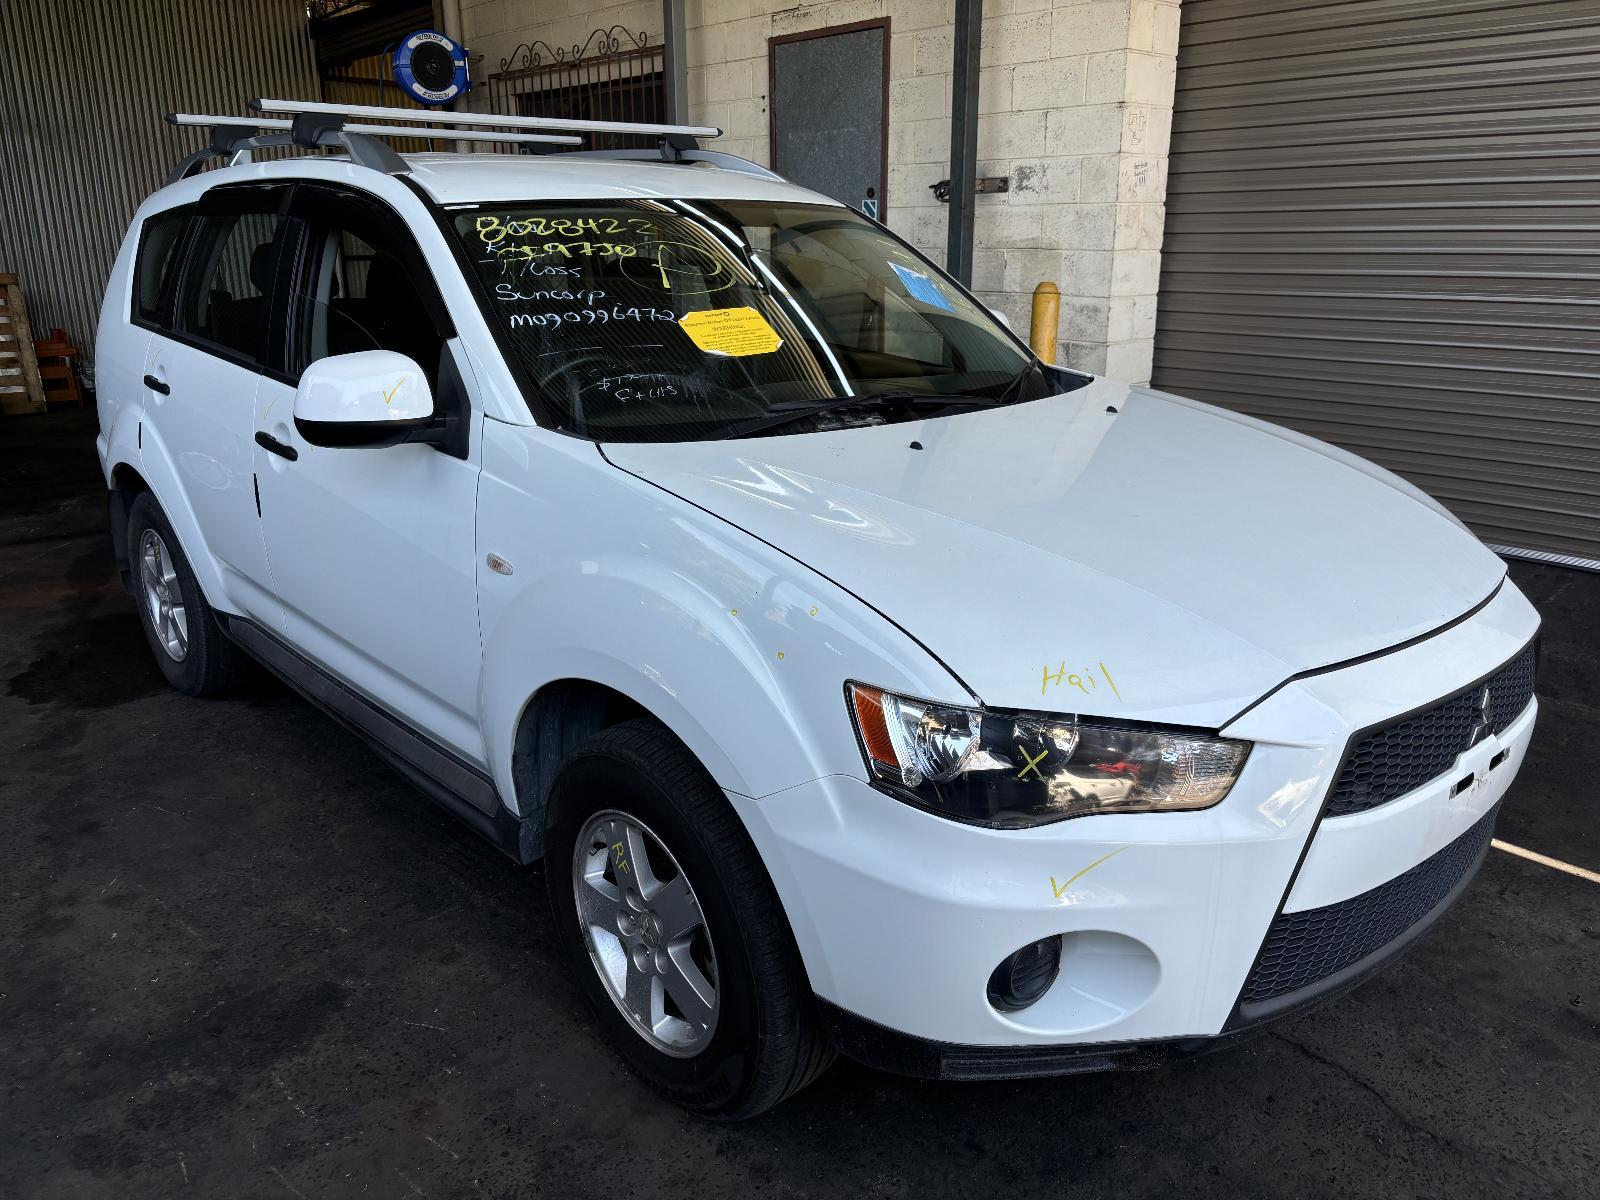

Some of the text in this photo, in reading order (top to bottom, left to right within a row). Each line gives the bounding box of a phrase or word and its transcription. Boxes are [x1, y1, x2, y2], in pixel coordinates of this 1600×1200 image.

[495, 283, 606, 306] Suncorp
[1041, 661, 1122, 702] Hail
[612, 841, 631, 874] RF
